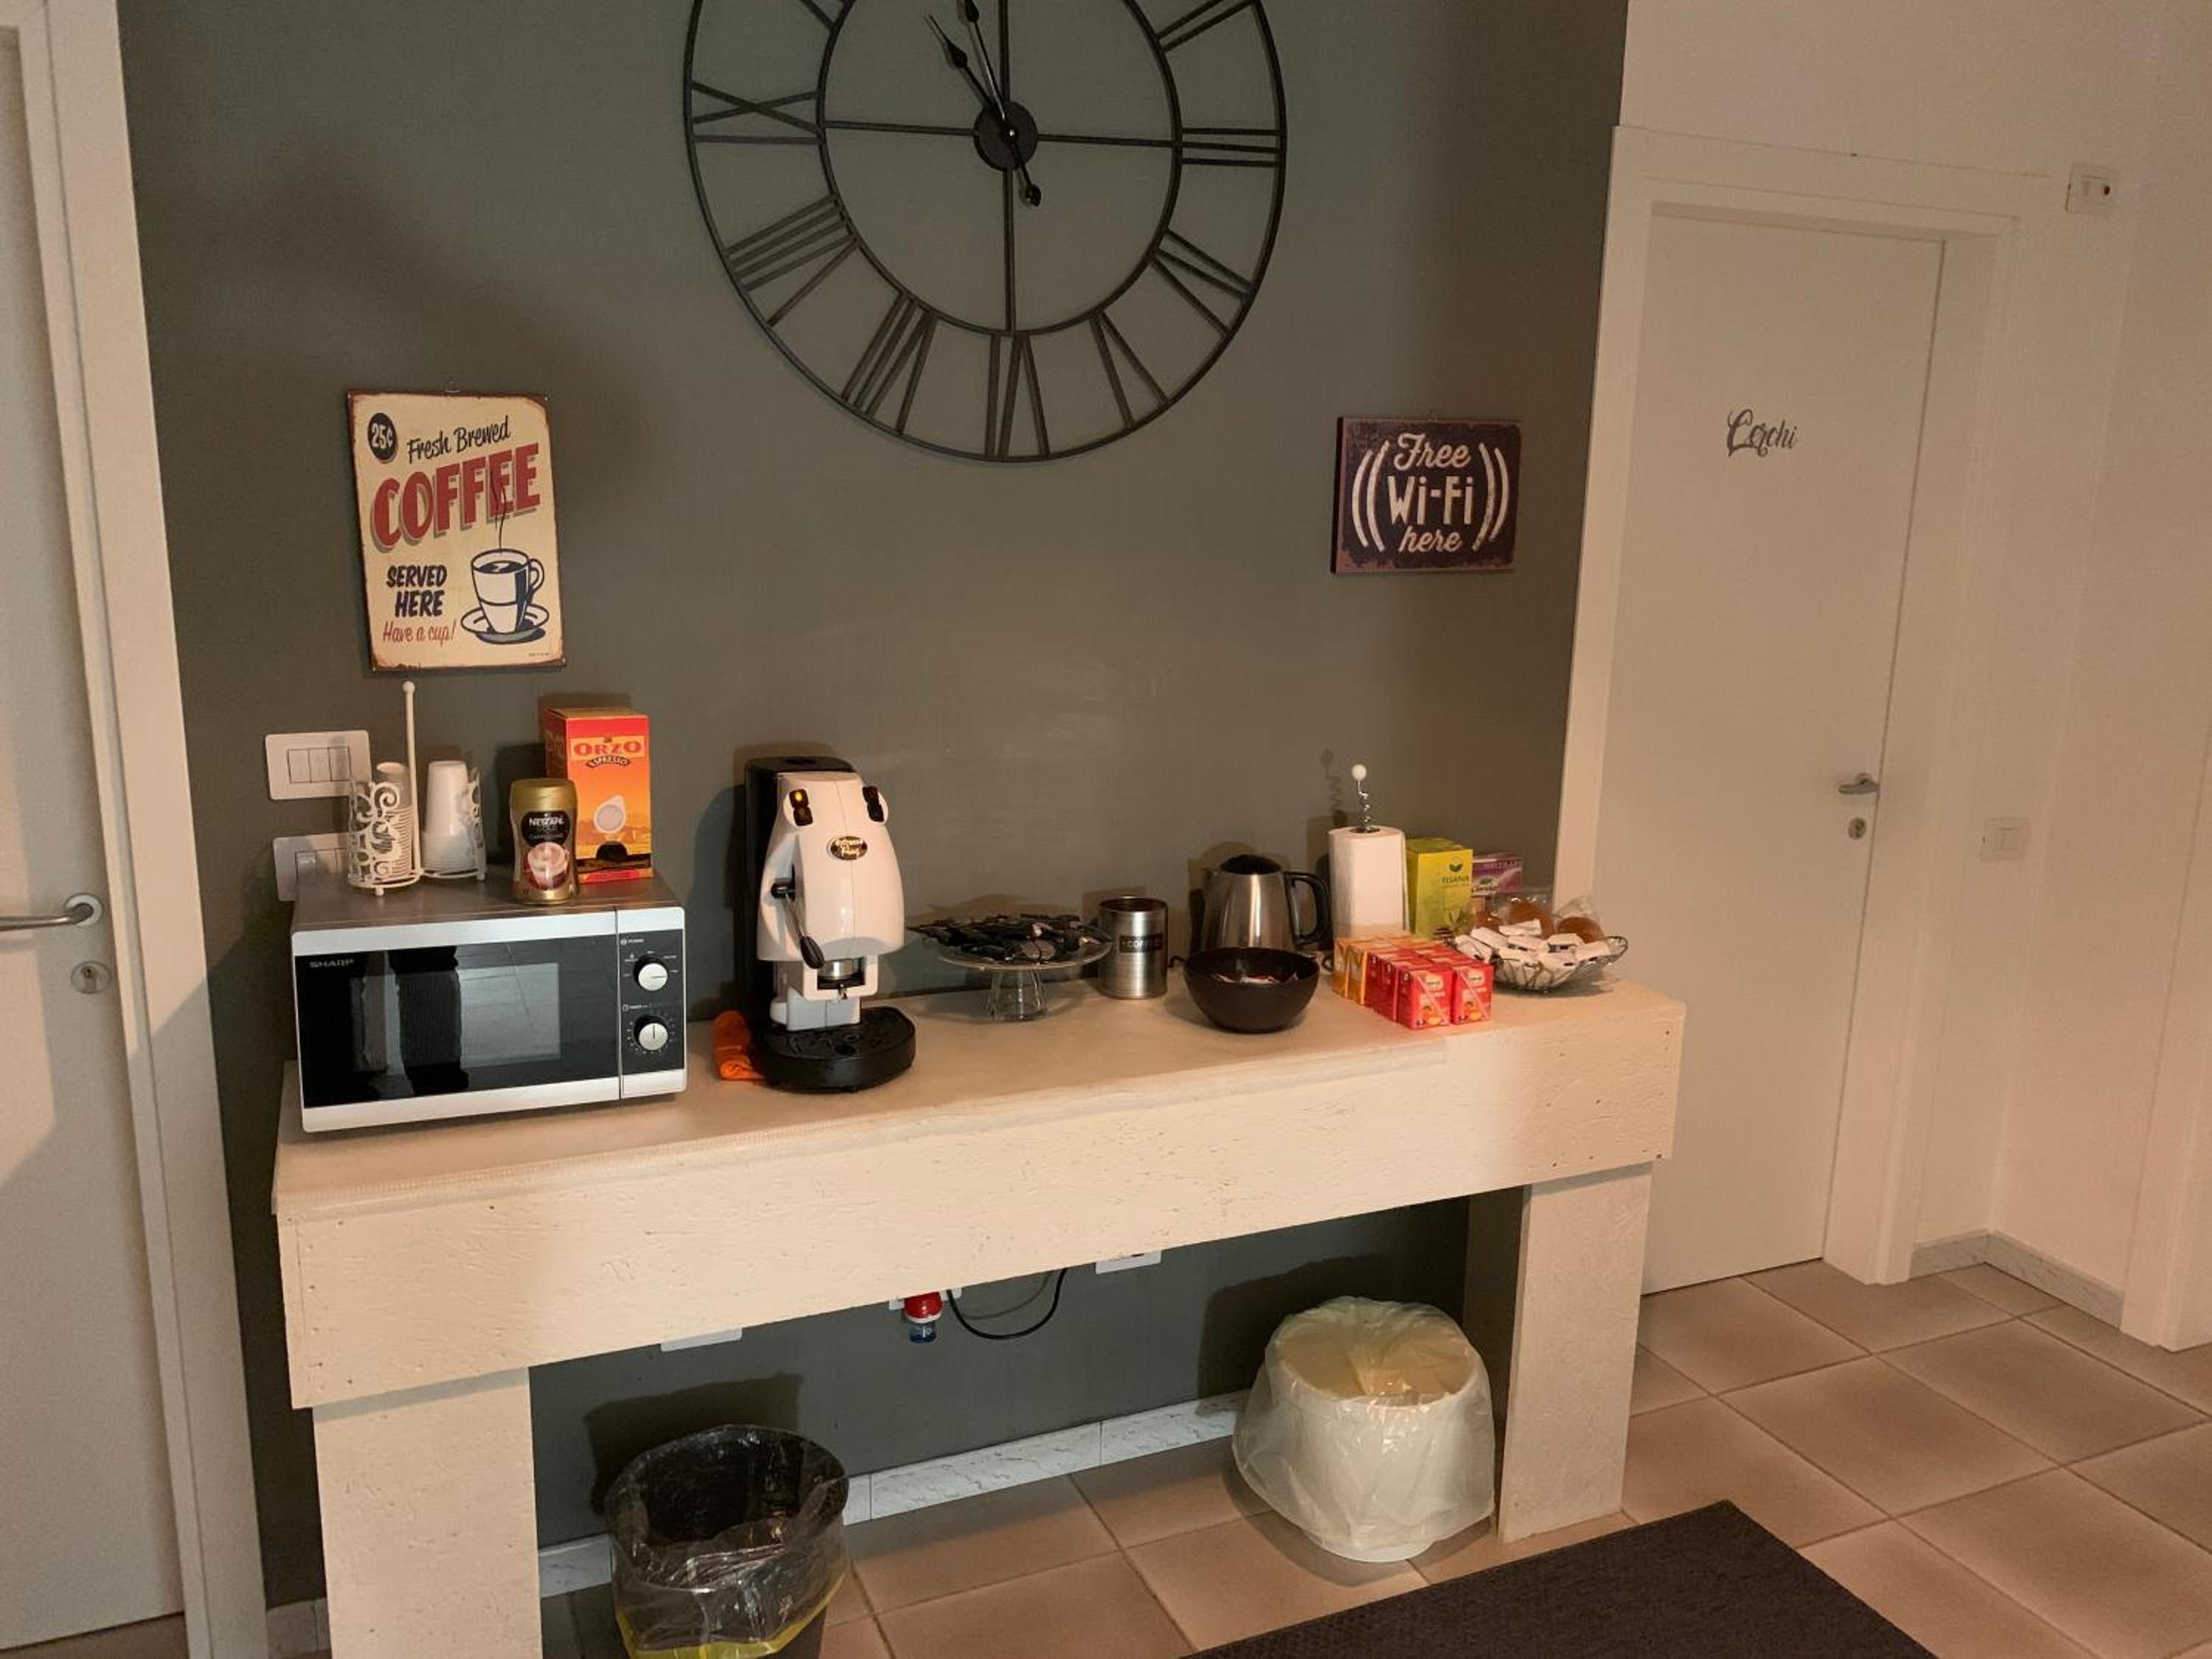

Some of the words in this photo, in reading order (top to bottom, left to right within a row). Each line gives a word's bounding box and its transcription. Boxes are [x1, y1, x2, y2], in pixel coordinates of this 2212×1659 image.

[407, 431, 451, 465] Fresh
[453, 415, 511, 453] Brewed
[1394, 433, 1471, 471] Free
[372, 442, 540, 549] COFFEE
[1387, 476, 1473, 525] Wi-Fi
[1399, 526, 1462, 552] here
[386, 564, 448, 588] SERVED
[394, 590, 445, 617] HERE
[383, 620, 413, 643] Have
[416, 626, 426, 641] a
[428, 619, 456, 647] cup!
[574, 741, 641, 756] ORZO
[309, 959, 355, 968] SHARP
